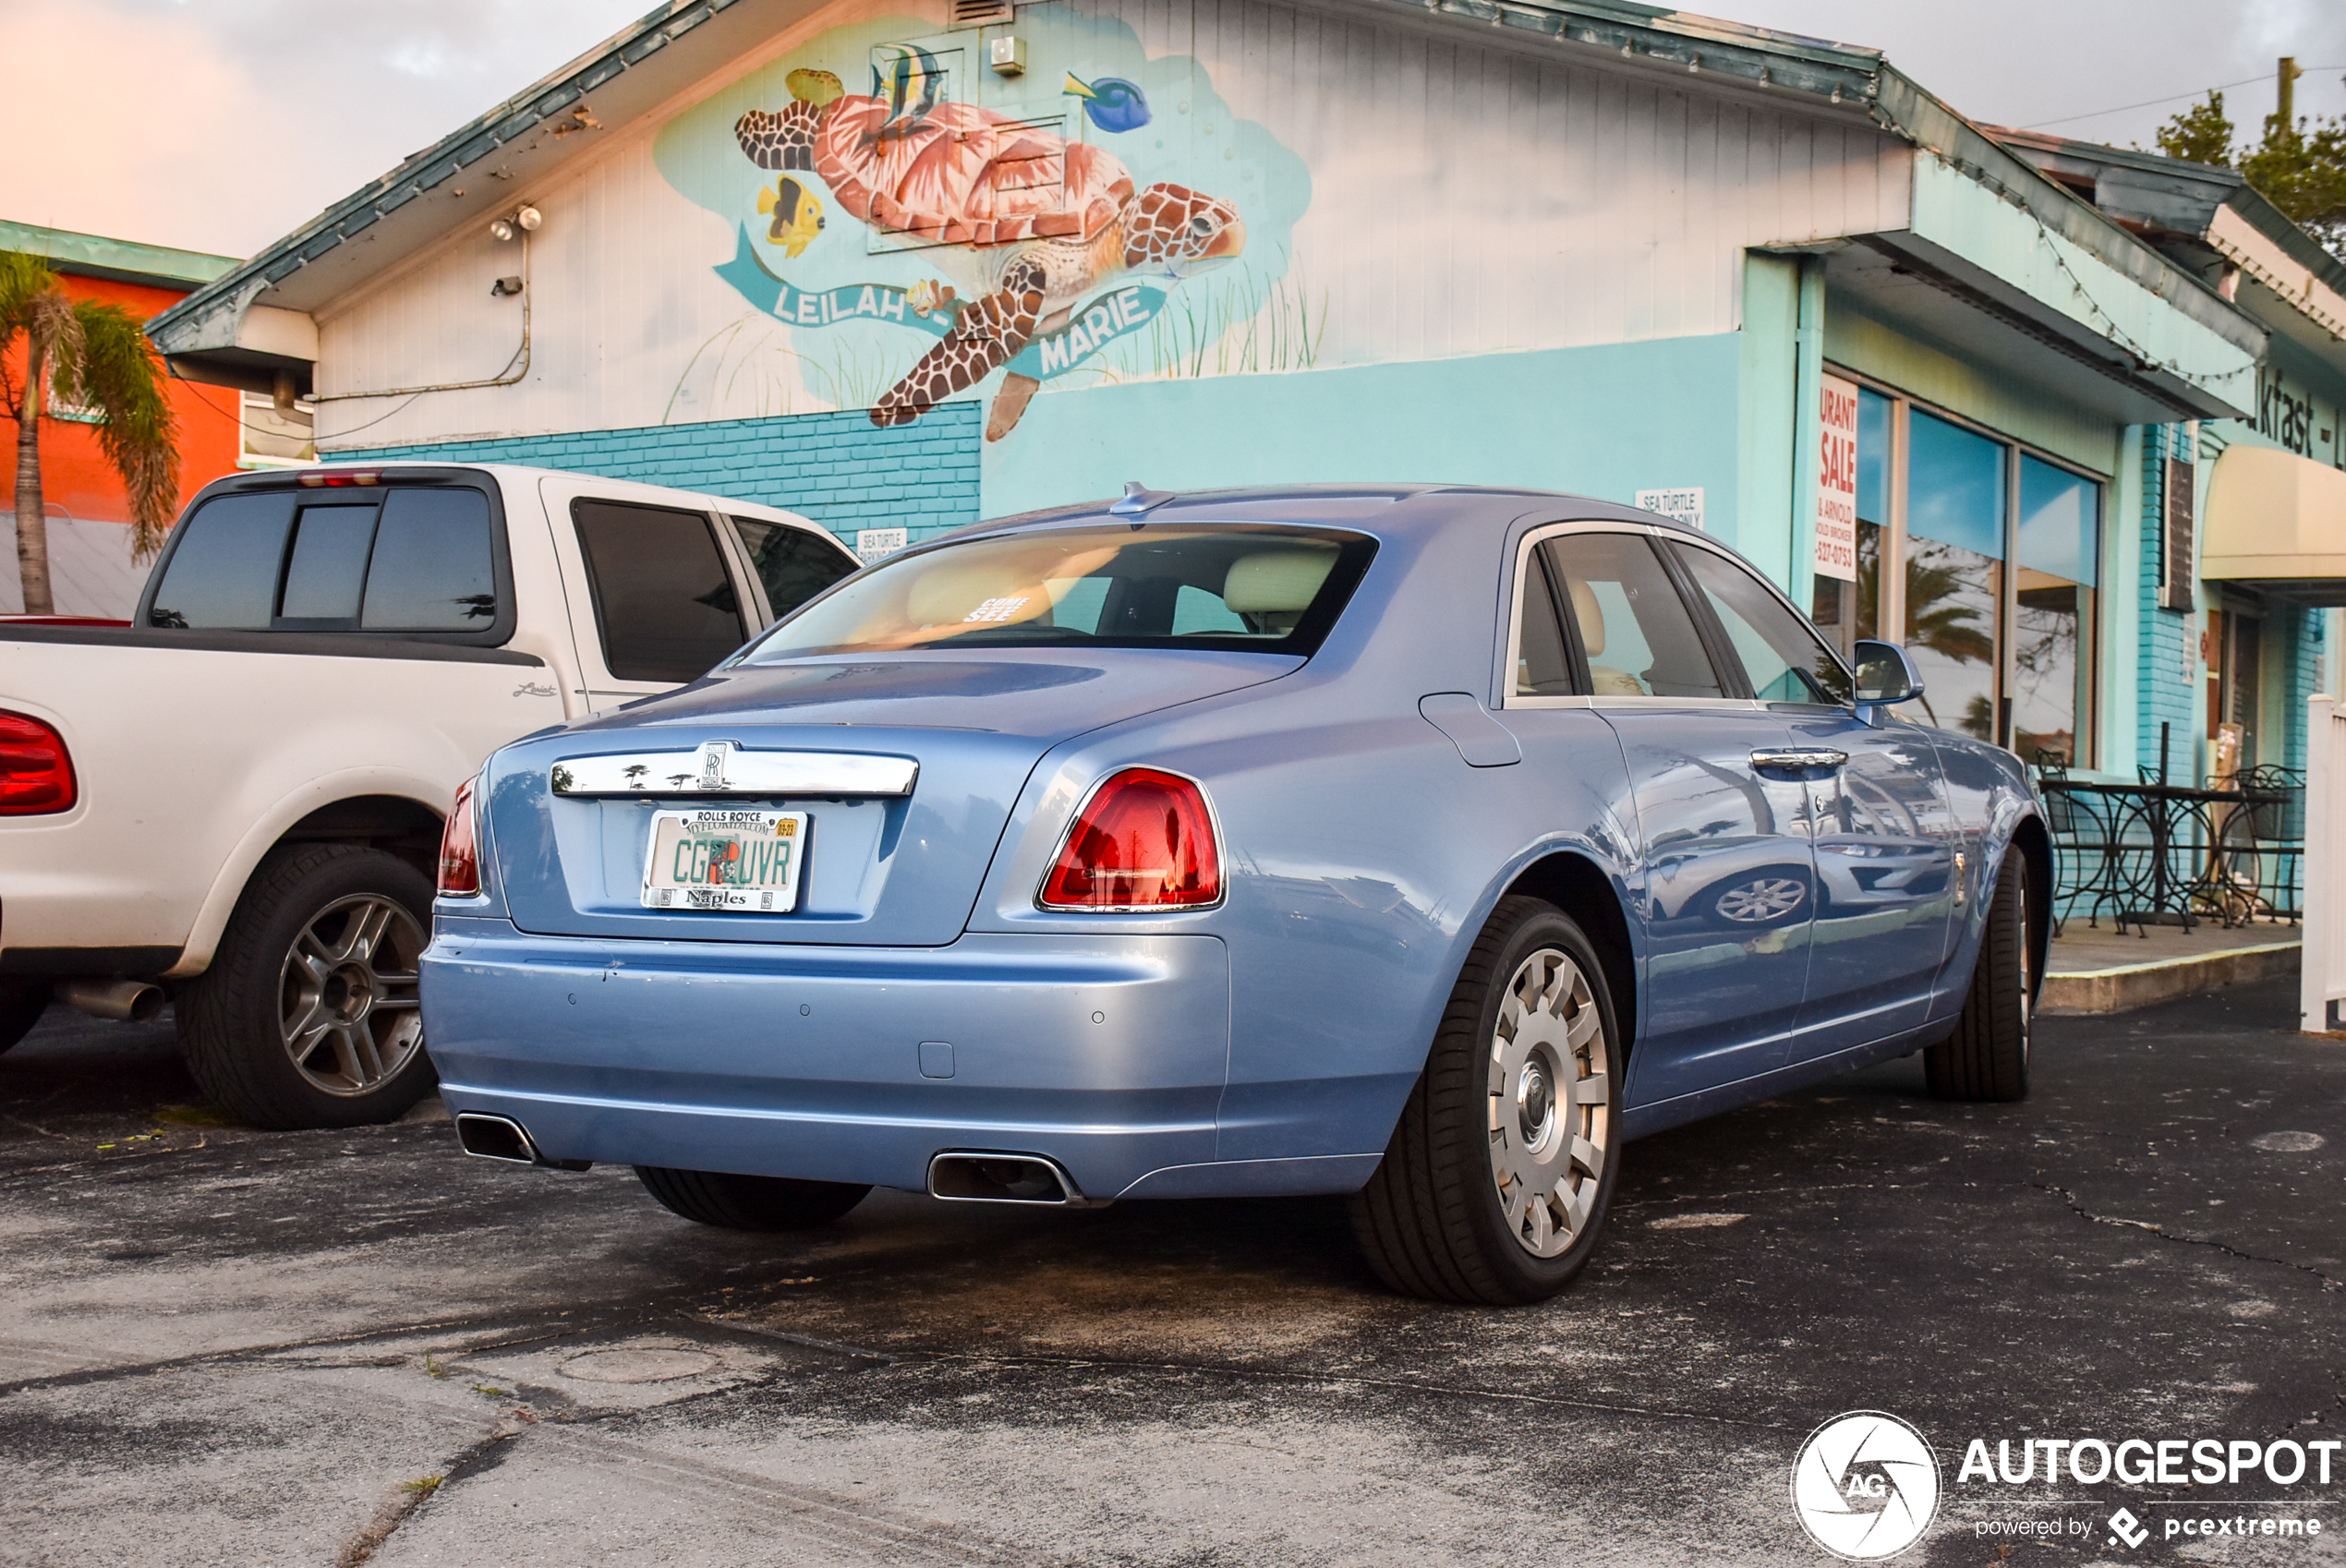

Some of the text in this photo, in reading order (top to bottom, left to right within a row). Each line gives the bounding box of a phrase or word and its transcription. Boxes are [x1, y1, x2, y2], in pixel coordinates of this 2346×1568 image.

[773, 285, 906, 324] LEILAH
[1038, 285, 1150, 375] MARIE
[1820, 430, 1855, 494] SALE
[1644, 493, 1695, 512] SEA TURTLE
[1824, 500, 1852, 525] ARNOLD
[864, 533, 901, 549] SEA TURTLE
[1830, 525, 1852, 542] BROKER
[981, 597, 1031, 608] COME
[962, 609, 1017, 622] SEE
[697, 811, 762, 823] ROLLS ROYCE
[685, 890, 747, 908] Naples
